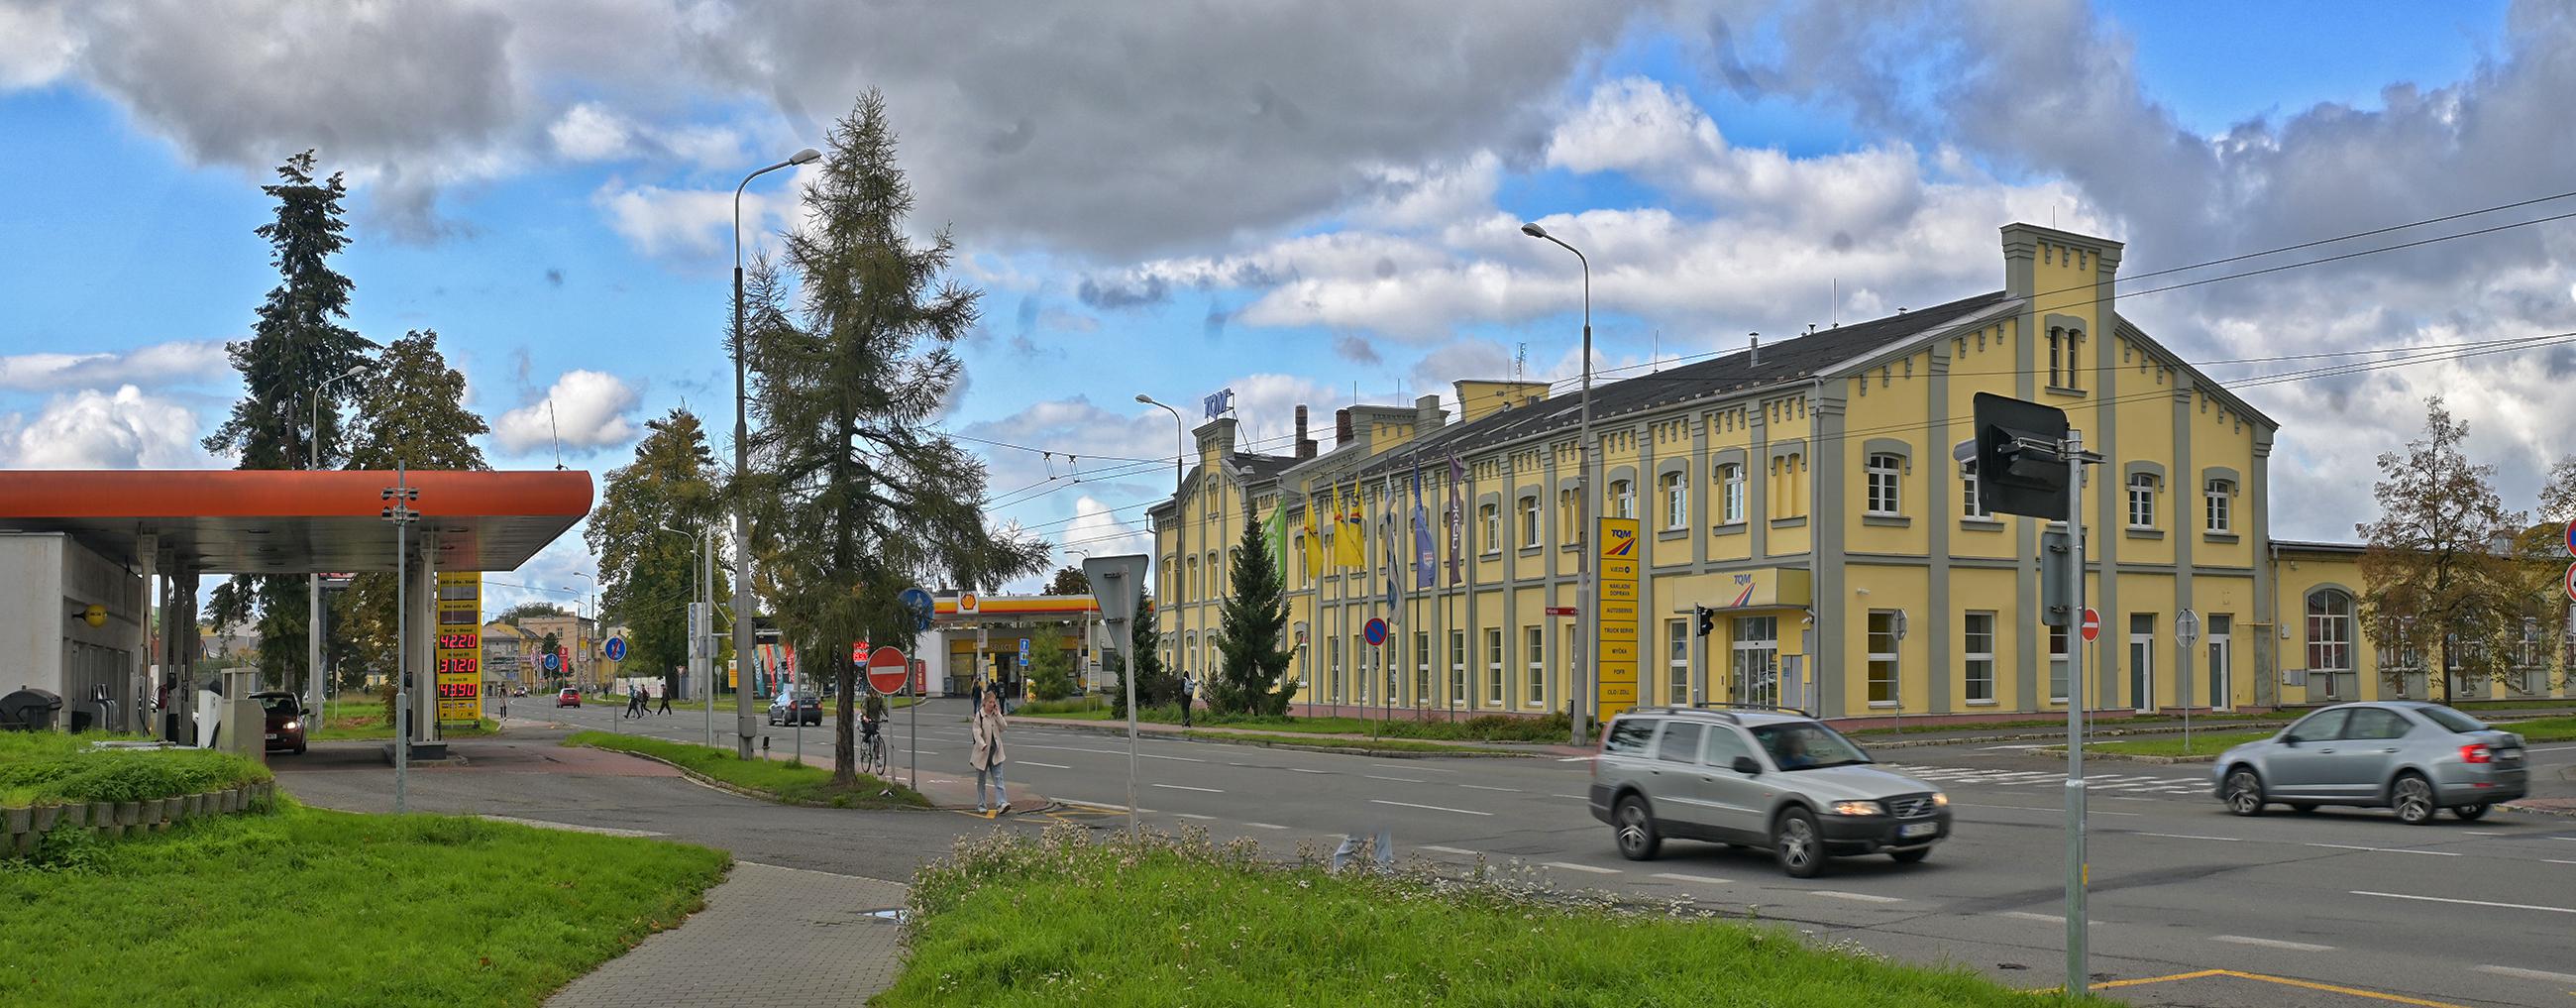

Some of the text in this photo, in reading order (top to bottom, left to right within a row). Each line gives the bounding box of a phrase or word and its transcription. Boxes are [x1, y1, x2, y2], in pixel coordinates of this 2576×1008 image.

[1203, 388, 1231, 420] TQM
[1611, 529, 1632, 539] TQM
[1734, 574, 1751, 586] TQM
